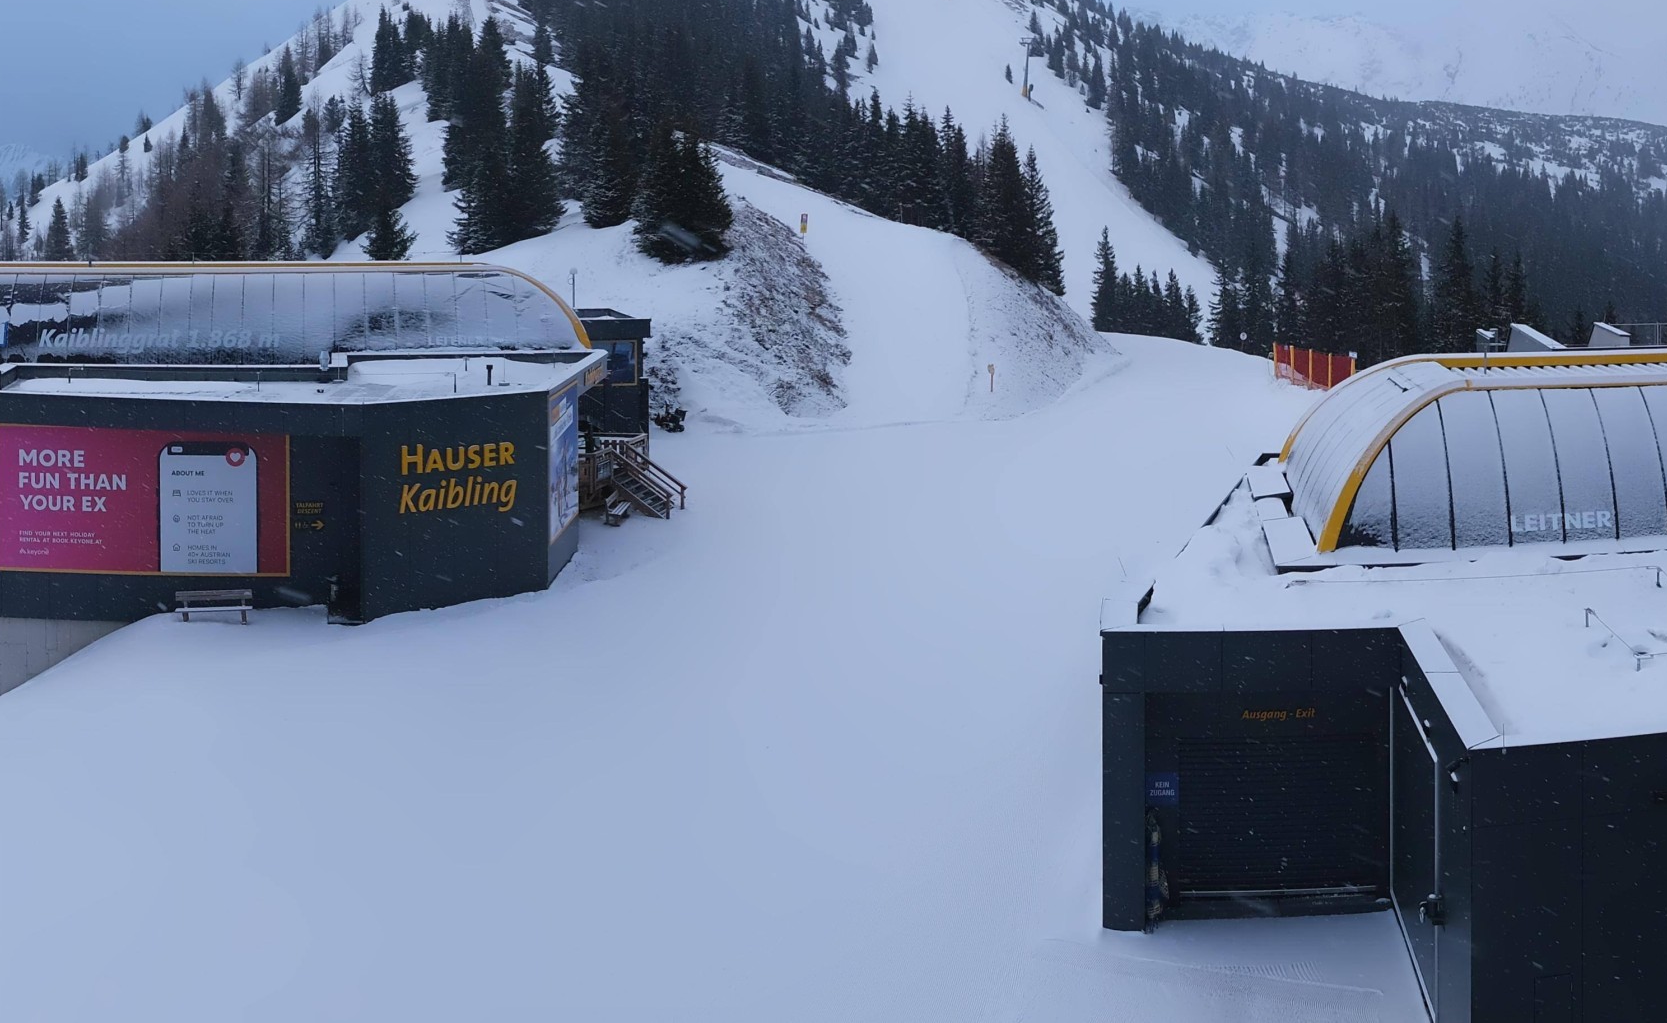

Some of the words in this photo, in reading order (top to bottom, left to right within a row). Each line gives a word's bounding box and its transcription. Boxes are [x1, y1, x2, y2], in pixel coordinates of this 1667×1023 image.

[38, 328, 181, 354] Kaiblinggrat
[18, 449, 85, 468] MORE
[401, 441, 515, 475] HAUSER
[18, 472, 60, 489] FUN
[67, 473, 127, 490] THAN
[19, 495, 75, 511] YOUR
[82, 496, 107, 512] EX
[399, 475, 518, 514] Kaibling
[1510, 511, 1612, 532] LEITNER
[1242, 709, 1287, 722] Ausgang
[1296, 708, 1316, 718] Exit
